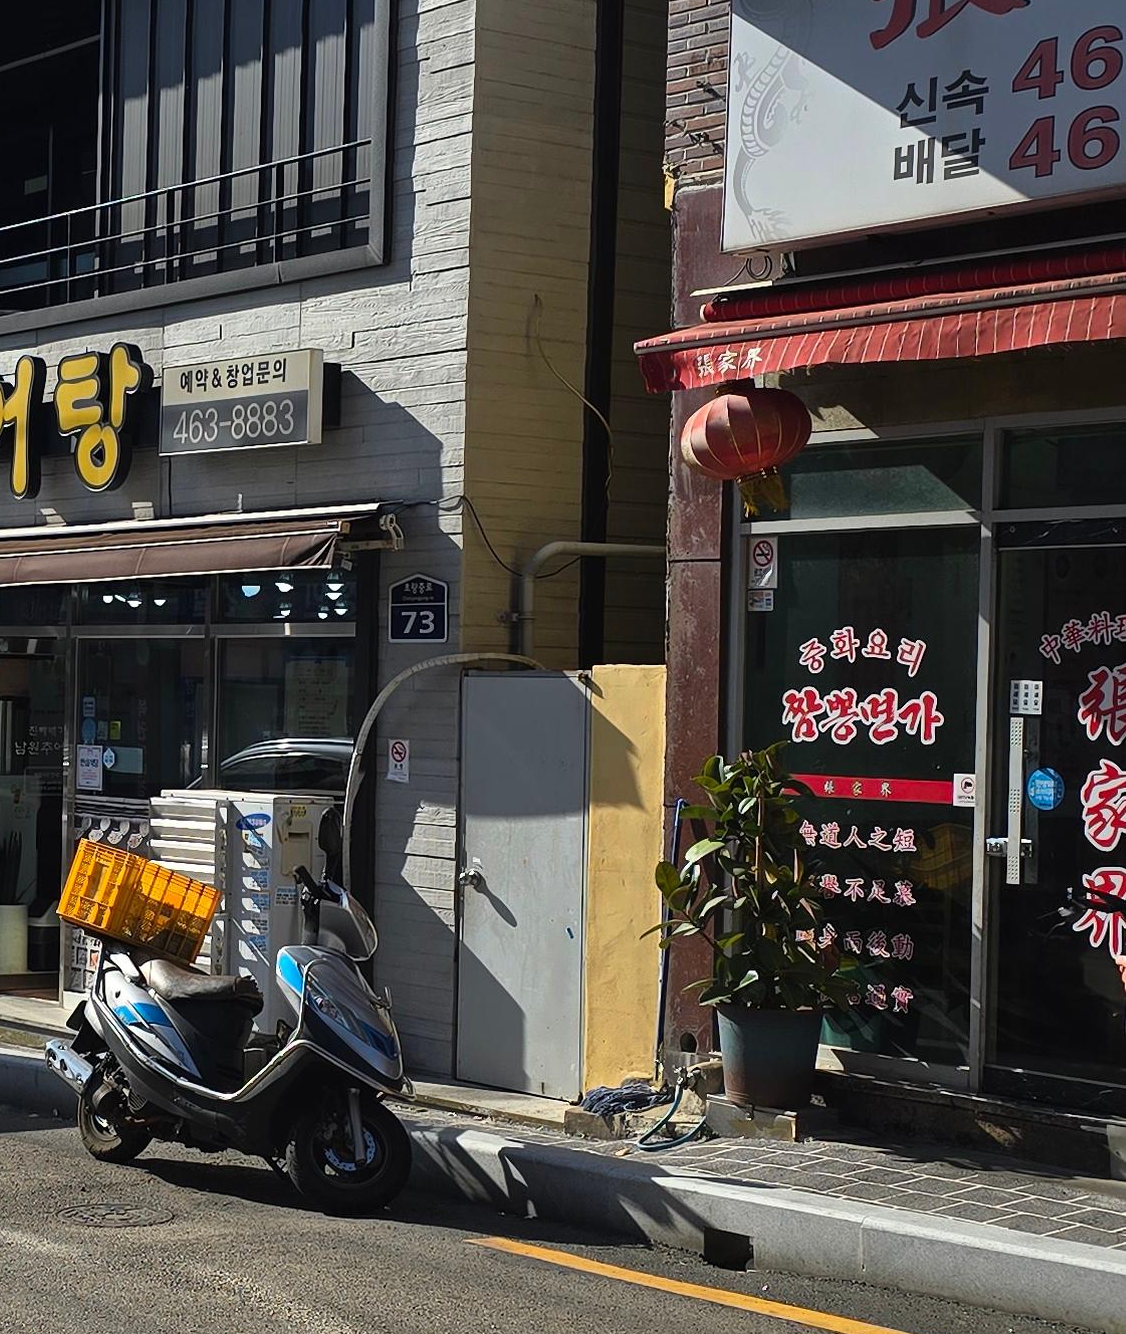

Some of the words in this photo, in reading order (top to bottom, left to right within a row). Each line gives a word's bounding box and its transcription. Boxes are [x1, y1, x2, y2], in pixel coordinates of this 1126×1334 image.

[896, 68, 990, 128] 신속
[893, 127, 987, 185] 배달
[180, 369, 209, 393] 예약
[212, 368, 222, 388] &
[226, 358, 287, 389] 창업문의
[173, 399, 294, 444] 463-8883
[401, 610, 435, 634] 73
[799, 626, 926, 677] 중화요리
